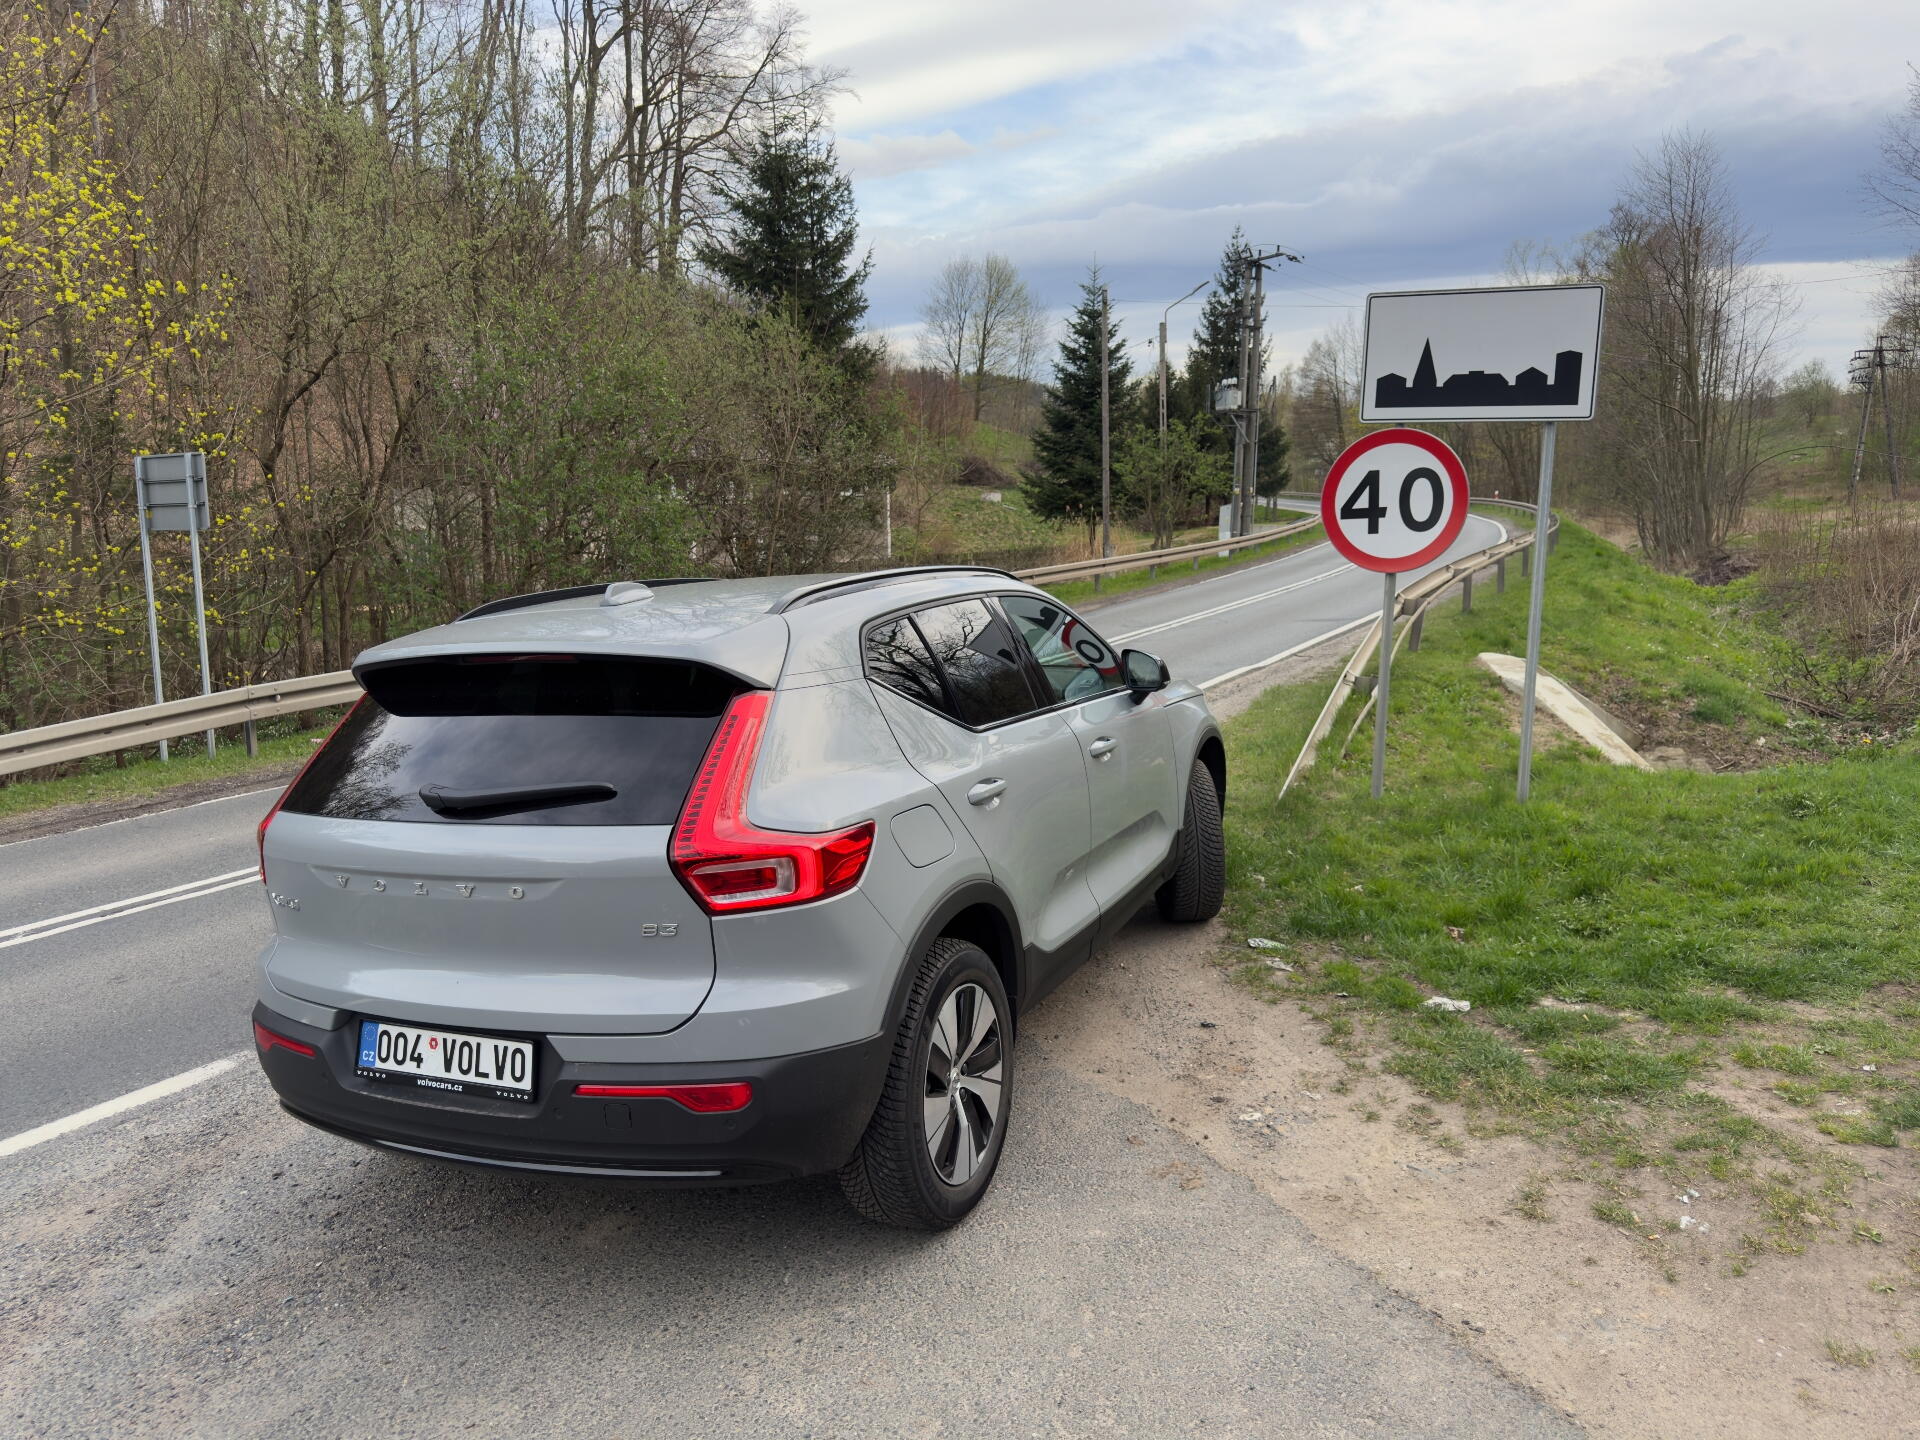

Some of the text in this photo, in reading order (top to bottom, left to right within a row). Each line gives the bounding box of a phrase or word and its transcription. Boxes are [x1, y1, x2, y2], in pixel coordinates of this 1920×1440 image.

[1340, 467, 1444, 534] 40
[336, 874, 525, 900] VOLVO
[641, 923, 679, 937] B3
[362, 1050, 375, 1062] CZ
[378, 1030, 526, 1083] 004 VOLVO
[356, 1070, 387, 1079] VOLVO
[417, 1078, 463, 1092] volvocars.cz
[496, 1090, 529, 1100] VOLVO
